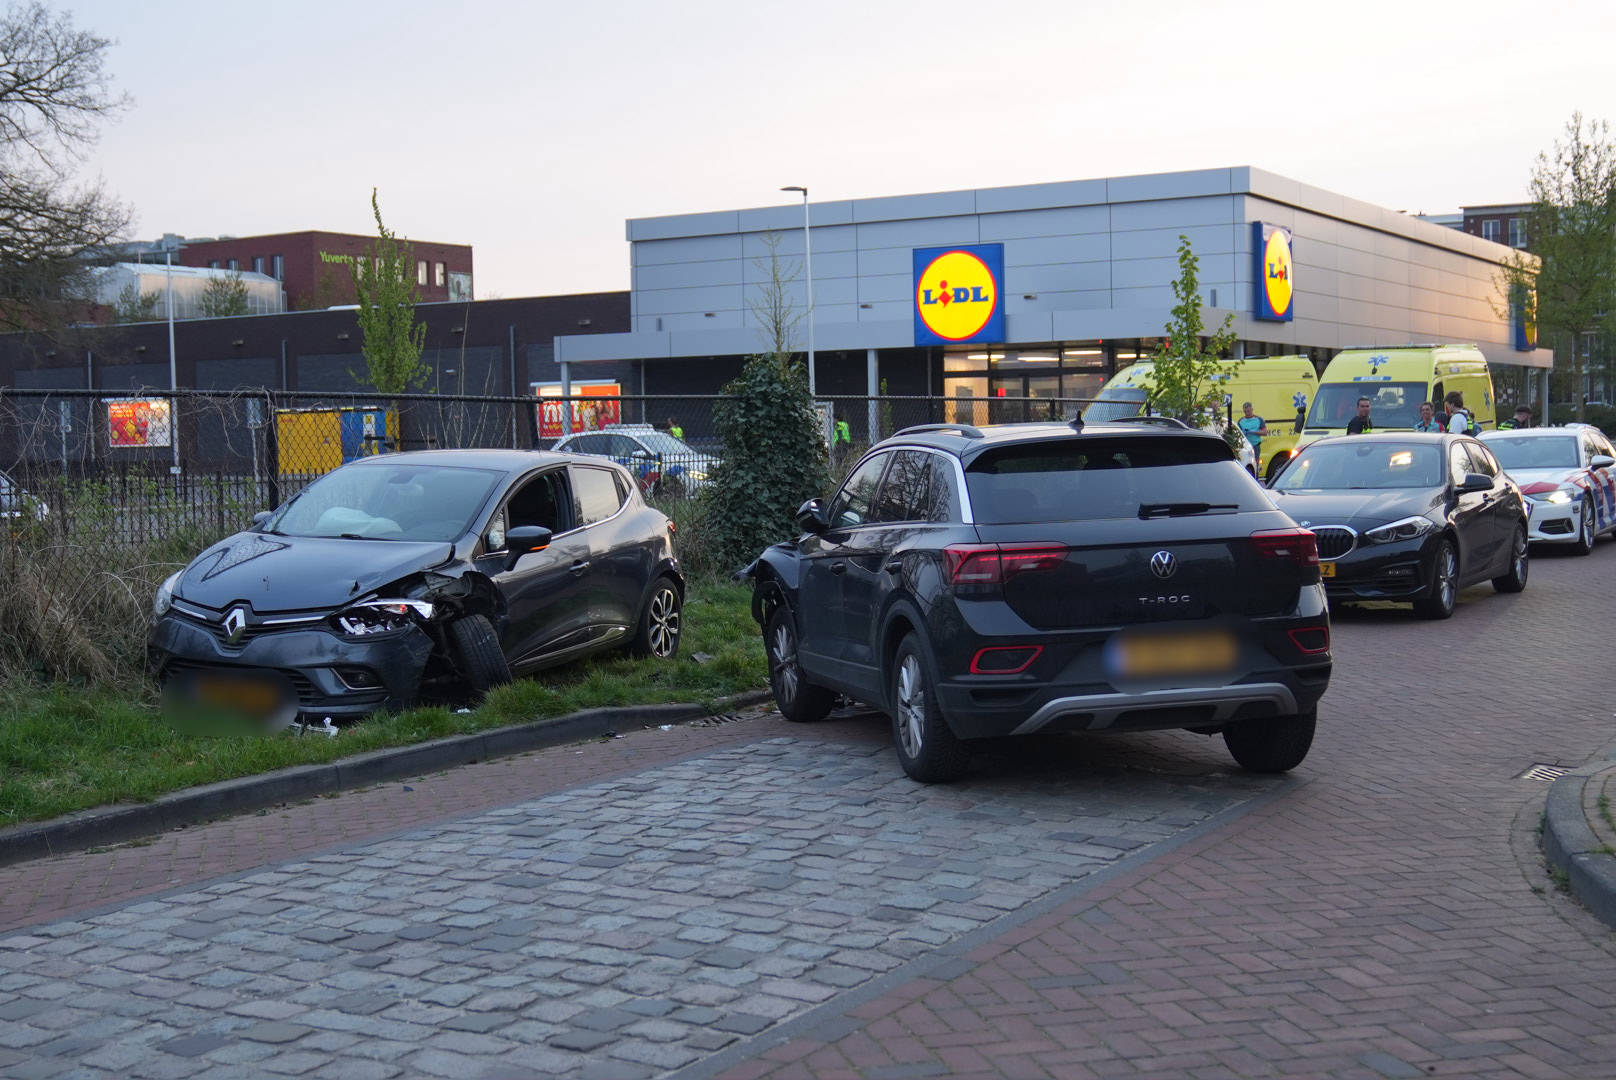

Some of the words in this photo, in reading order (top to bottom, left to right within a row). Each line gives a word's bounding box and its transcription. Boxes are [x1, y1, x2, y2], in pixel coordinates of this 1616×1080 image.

[320, 250, 354, 264] Yuverta
[923, 280, 989, 309] LIDL
[1138, 595, 1191, 605] T-ROC
